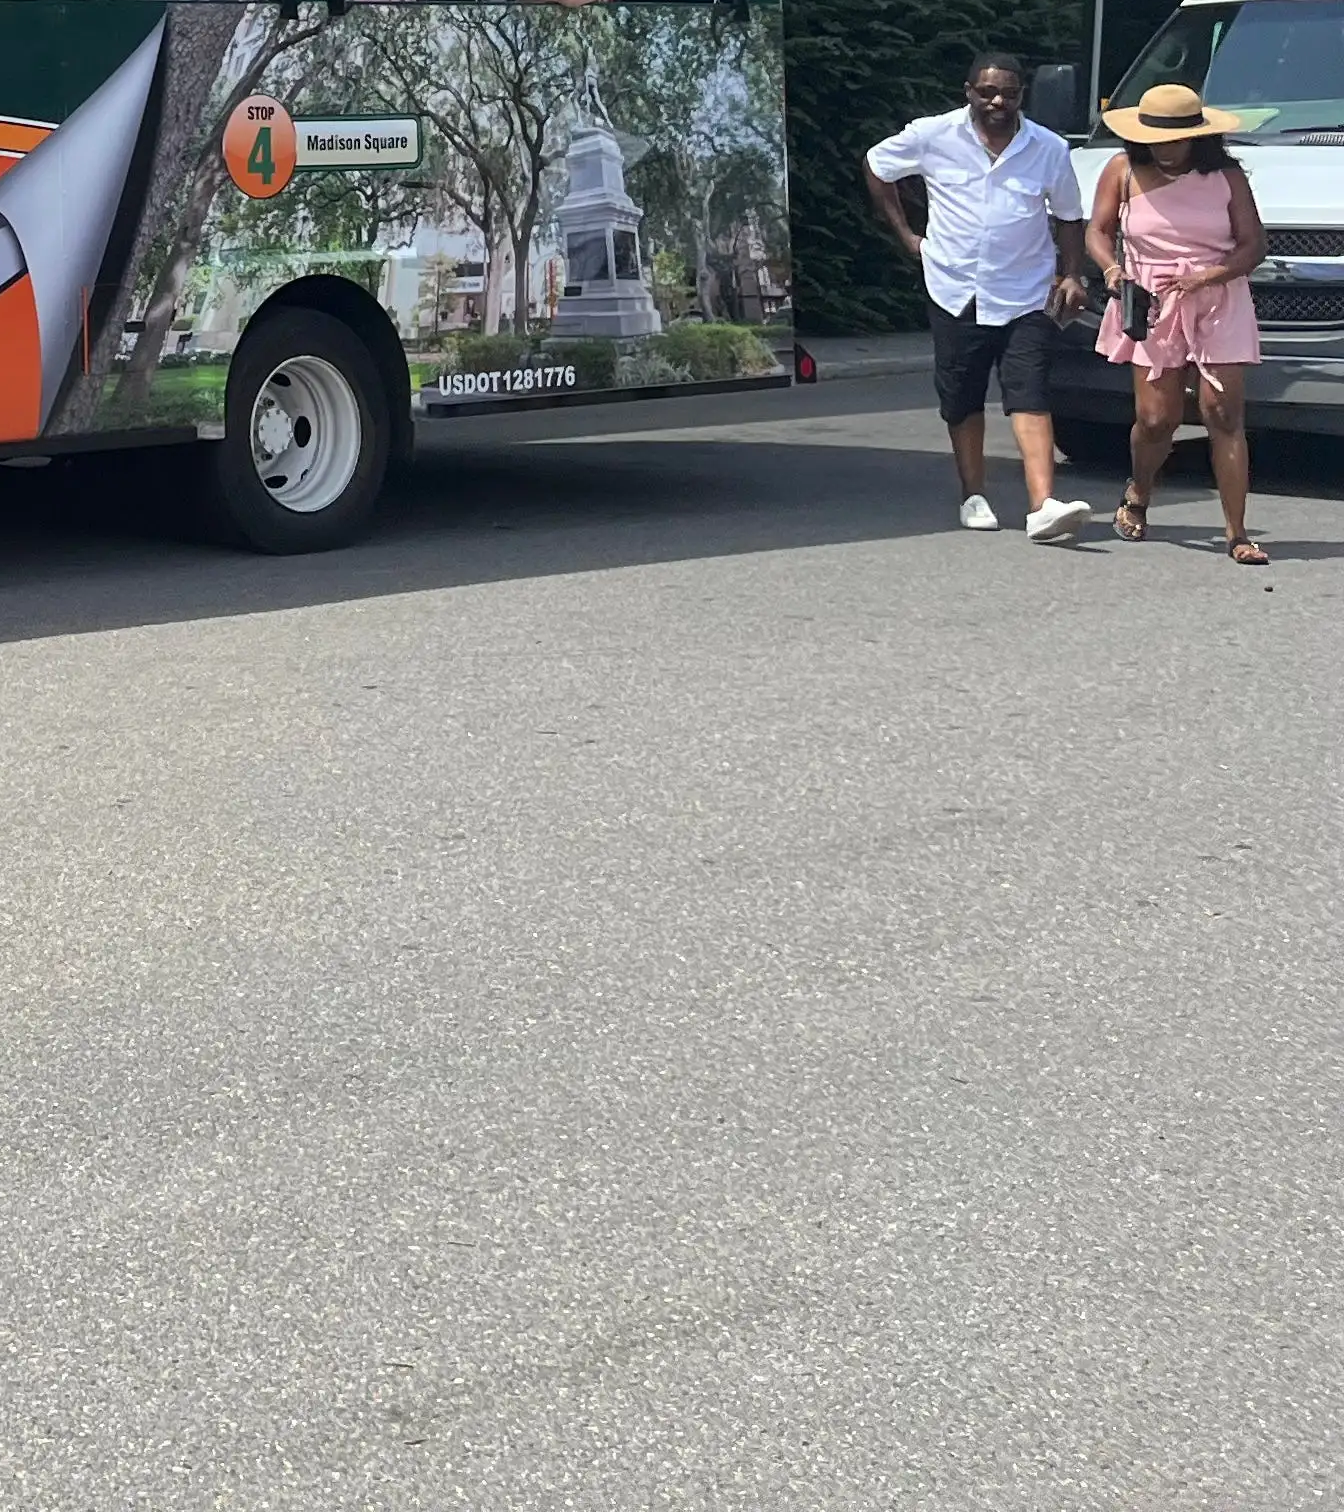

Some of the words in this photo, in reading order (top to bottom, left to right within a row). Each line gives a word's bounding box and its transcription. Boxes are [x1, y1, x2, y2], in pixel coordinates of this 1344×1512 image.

[247, 105, 275, 121] STOP
[247, 126, 276, 185] 4
[307, 135, 361, 151] Madison
[364, 133, 408, 153] Square
